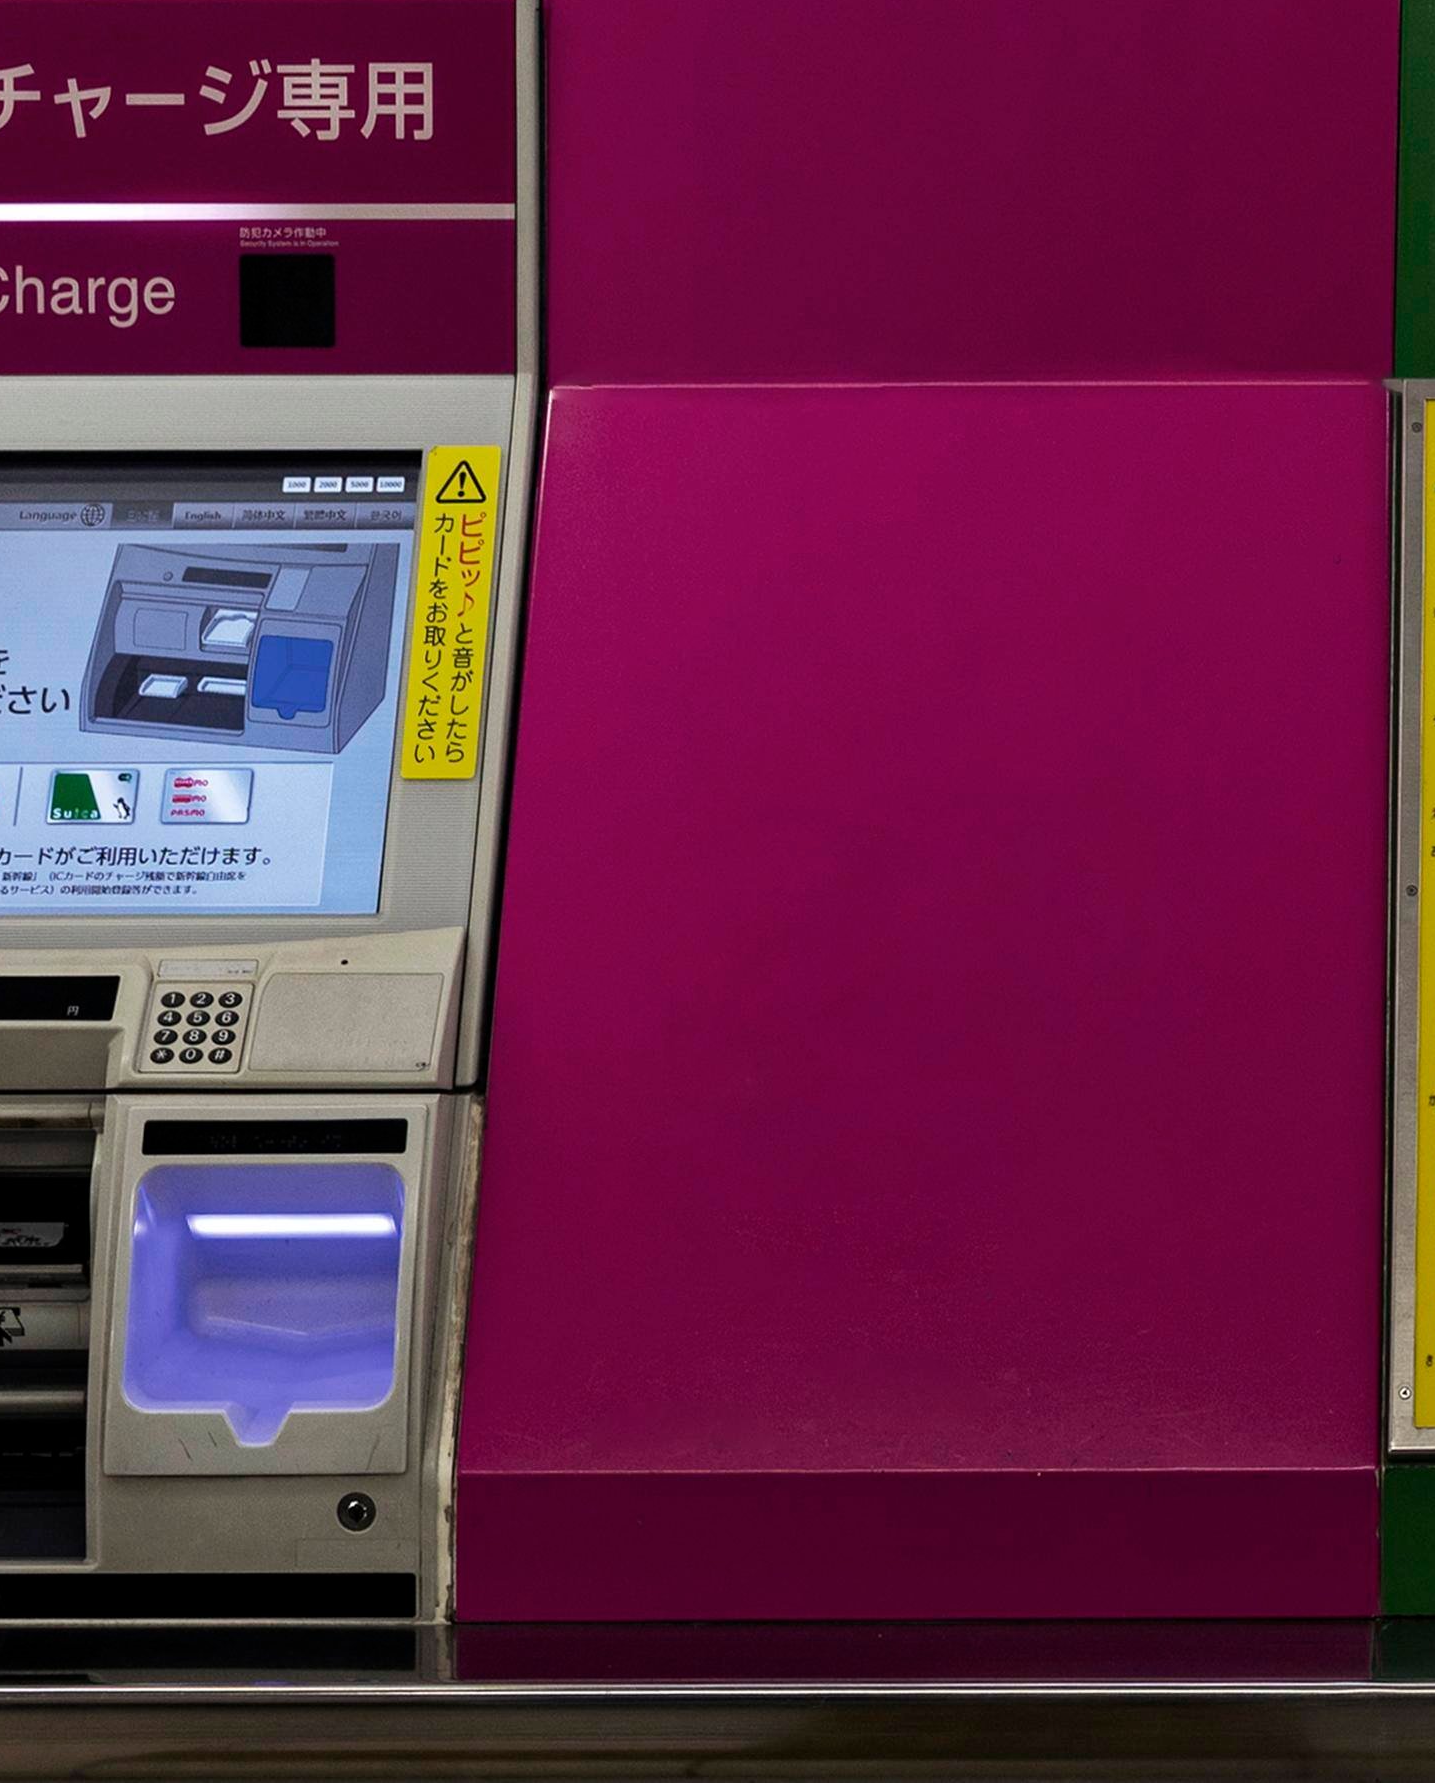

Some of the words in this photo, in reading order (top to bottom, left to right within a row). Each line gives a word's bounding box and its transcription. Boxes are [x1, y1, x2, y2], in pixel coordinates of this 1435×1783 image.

[413, 513, 455, 763] カードをお取りください
